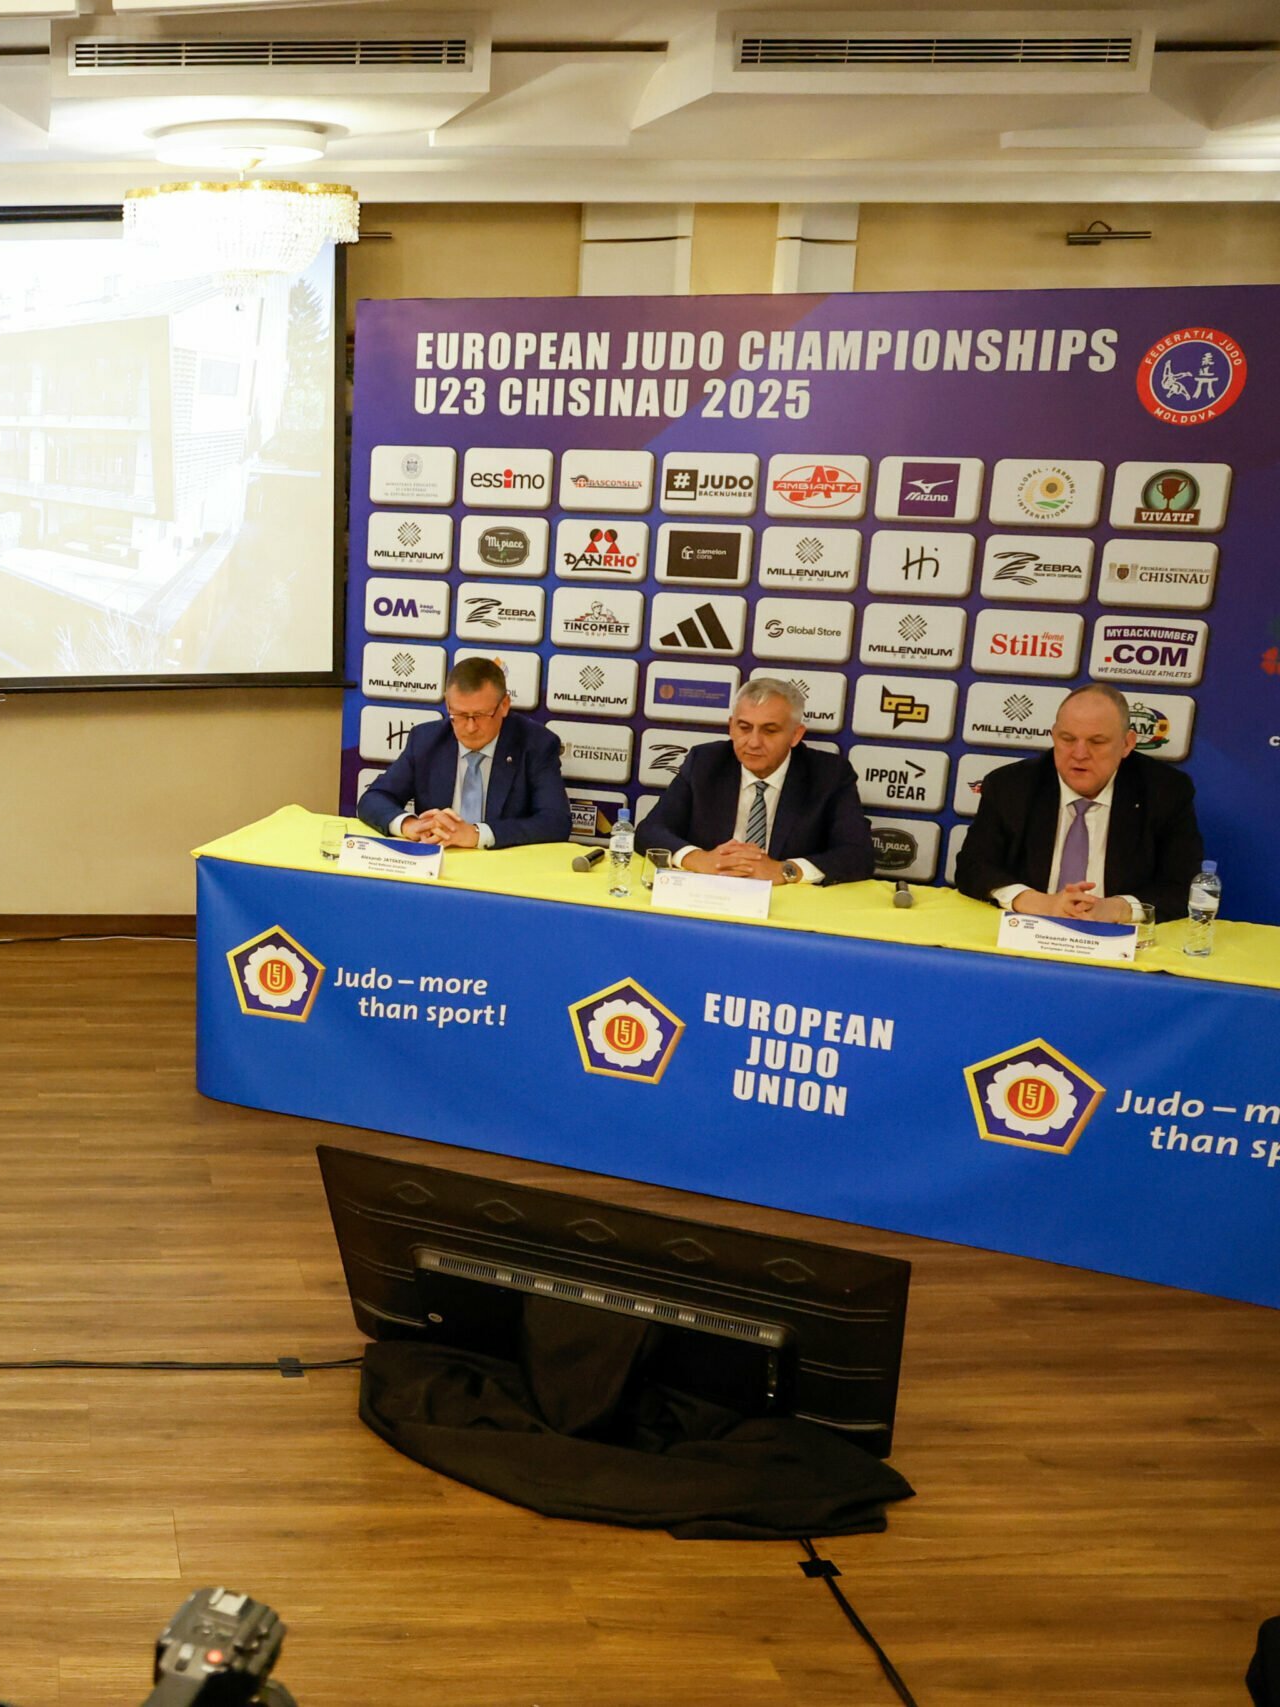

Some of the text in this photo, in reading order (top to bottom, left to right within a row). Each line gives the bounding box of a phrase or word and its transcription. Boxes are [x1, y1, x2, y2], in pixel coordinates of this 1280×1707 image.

[416, 328, 1118, 372] EUROPEAN JUDO CHAMPIONSHIPS
[1144, 330, 1214, 365] FEDERATIA
[1219, 339, 1243, 366] JUDO
[414, 377, 811, 419] U23 CHISINAU 2025
[1153, 407, 1216, 423] MOLDOVA
[470, 469, 545, 489] essimo
[699, 475, 754, 490] JUDO
[775, 481, 859, 492] AMBIANTA
[1018, 466, 1076, 495] GLOBAL FARMING
[698, 490, 753, 498] BACKNUMBER
[1017, 498, 1075, 520] INTERNATIONAL
[1140, 511, 1195, 523] VIVATIP
[374, 550, 444, 560] MILLENNIUM
[564, 552, 637, 571] DANRHO
[767, 567, 849, 579] MILLENNIUM
[1034, 563, 1082, 573] ZEBRA
[373, 596, 419, 617] OM
[498, 608, 536, 617] ZEBRA
[563, 622, 630, 634] TINCOMERT
[786, 626, 841, 637] Global Store
[868, 644, 953, 657] MILLENNIUM
[990, 633, 1064, 658] Stilis
[1109, 667, 1157, 677] PERSONALIZE
[1157, 670, 1192, 678] ATHLETES
[369, 679, 437, 690] MILLENNIUM
[554, 692, 628, 705] MILLENNIUM
[865, 768, 908, 785] IPPON
[887, 784, 926, 801] GEAR
[1070, 938, 1100, 946] NAGIBIN
[334, 967, 488, 996] Judo more
[358, 996, 418, 1020] than
[704, 992, 895, 1050] EUROPEAN
[746, 1036, 839, 1078] JUDO
[733, 1069, 847, 1116] UNION
[1116, 1089, 1204, 1118] Judo
[1150, 1125, 1238, 1156] than
